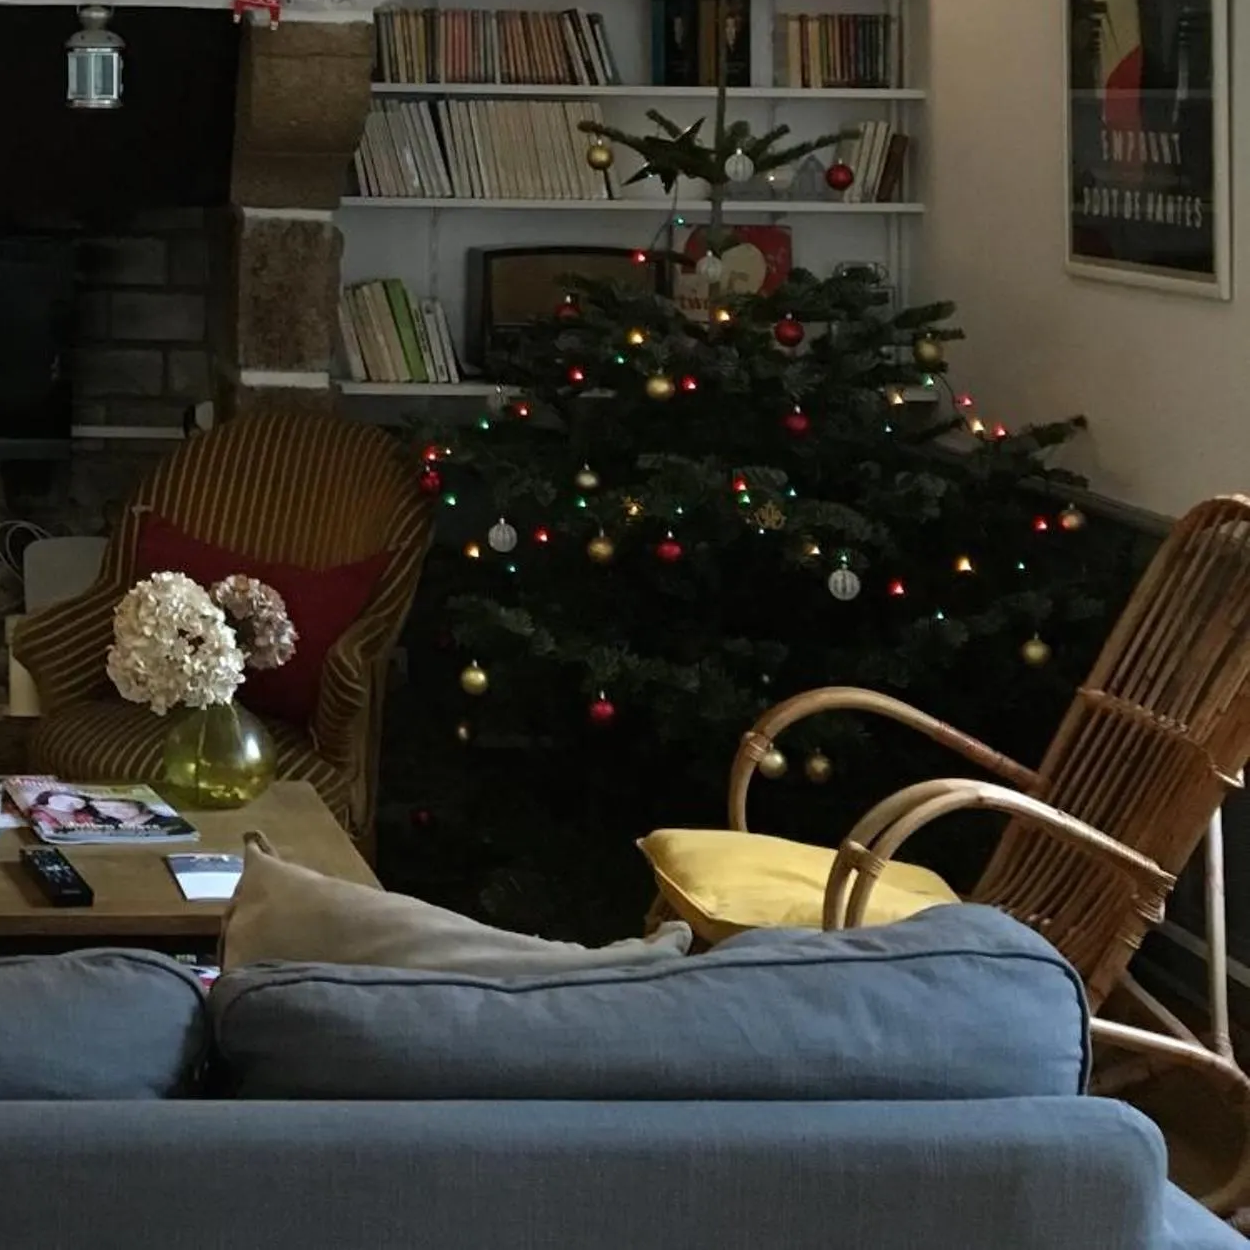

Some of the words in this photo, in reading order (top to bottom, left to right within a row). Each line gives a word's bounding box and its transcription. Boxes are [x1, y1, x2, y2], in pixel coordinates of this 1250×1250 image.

[1101, 129, 1181, 165] EMPRUNT
[1082, 187, 1119, 218] PORT
[1124, 190, 1141, 221] DE
[1146, 192, 1203, 229] NANTES
